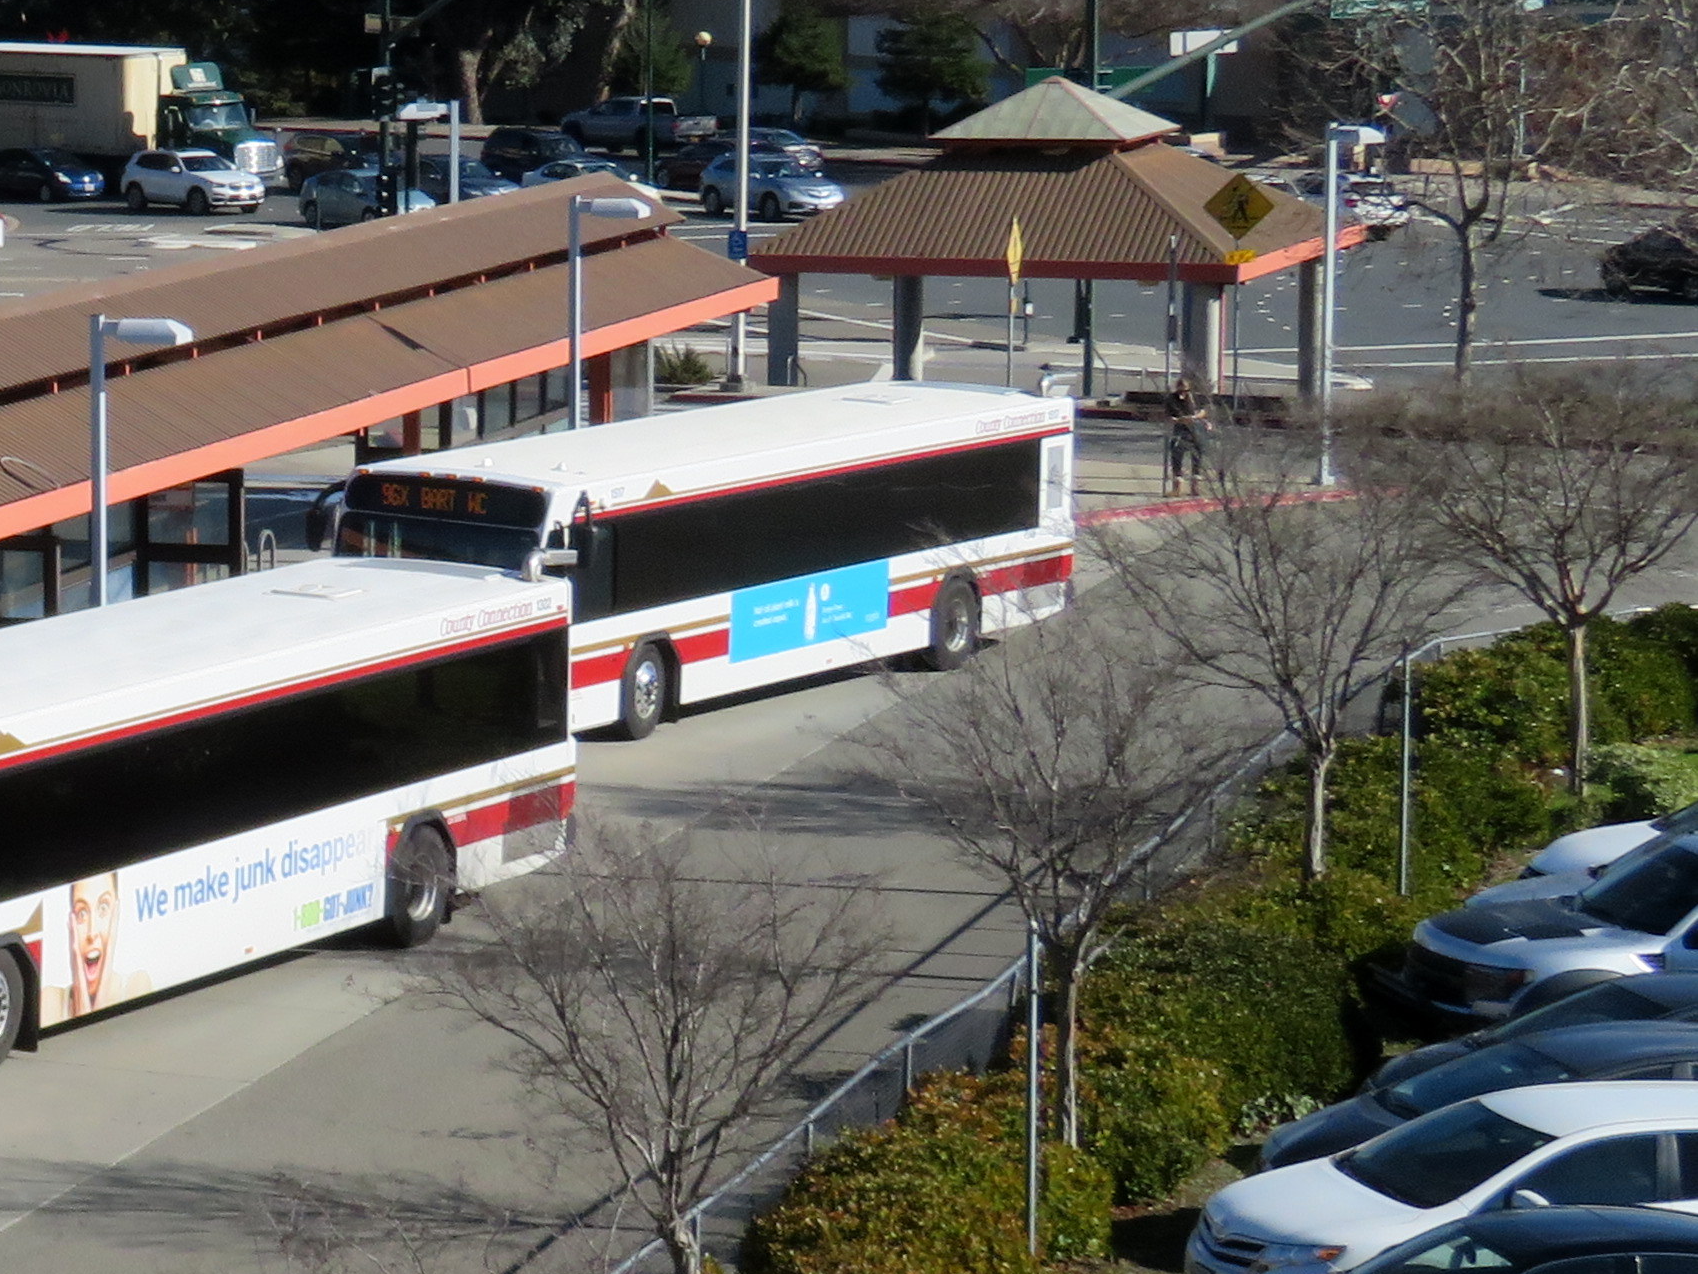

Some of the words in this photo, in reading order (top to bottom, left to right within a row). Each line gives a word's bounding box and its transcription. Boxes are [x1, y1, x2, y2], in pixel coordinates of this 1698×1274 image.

[381, 483, 409, 506] 96X
[421, 487, 456, 511] BART
[467, 492, 489, 514] WC
[440, 614, 476, 636] County
[478, 602, 533, 628] Connection
[135, 883, 168, 922] We
[173, 865, 230, 911] make
[232, 848, 277, 903] junk
